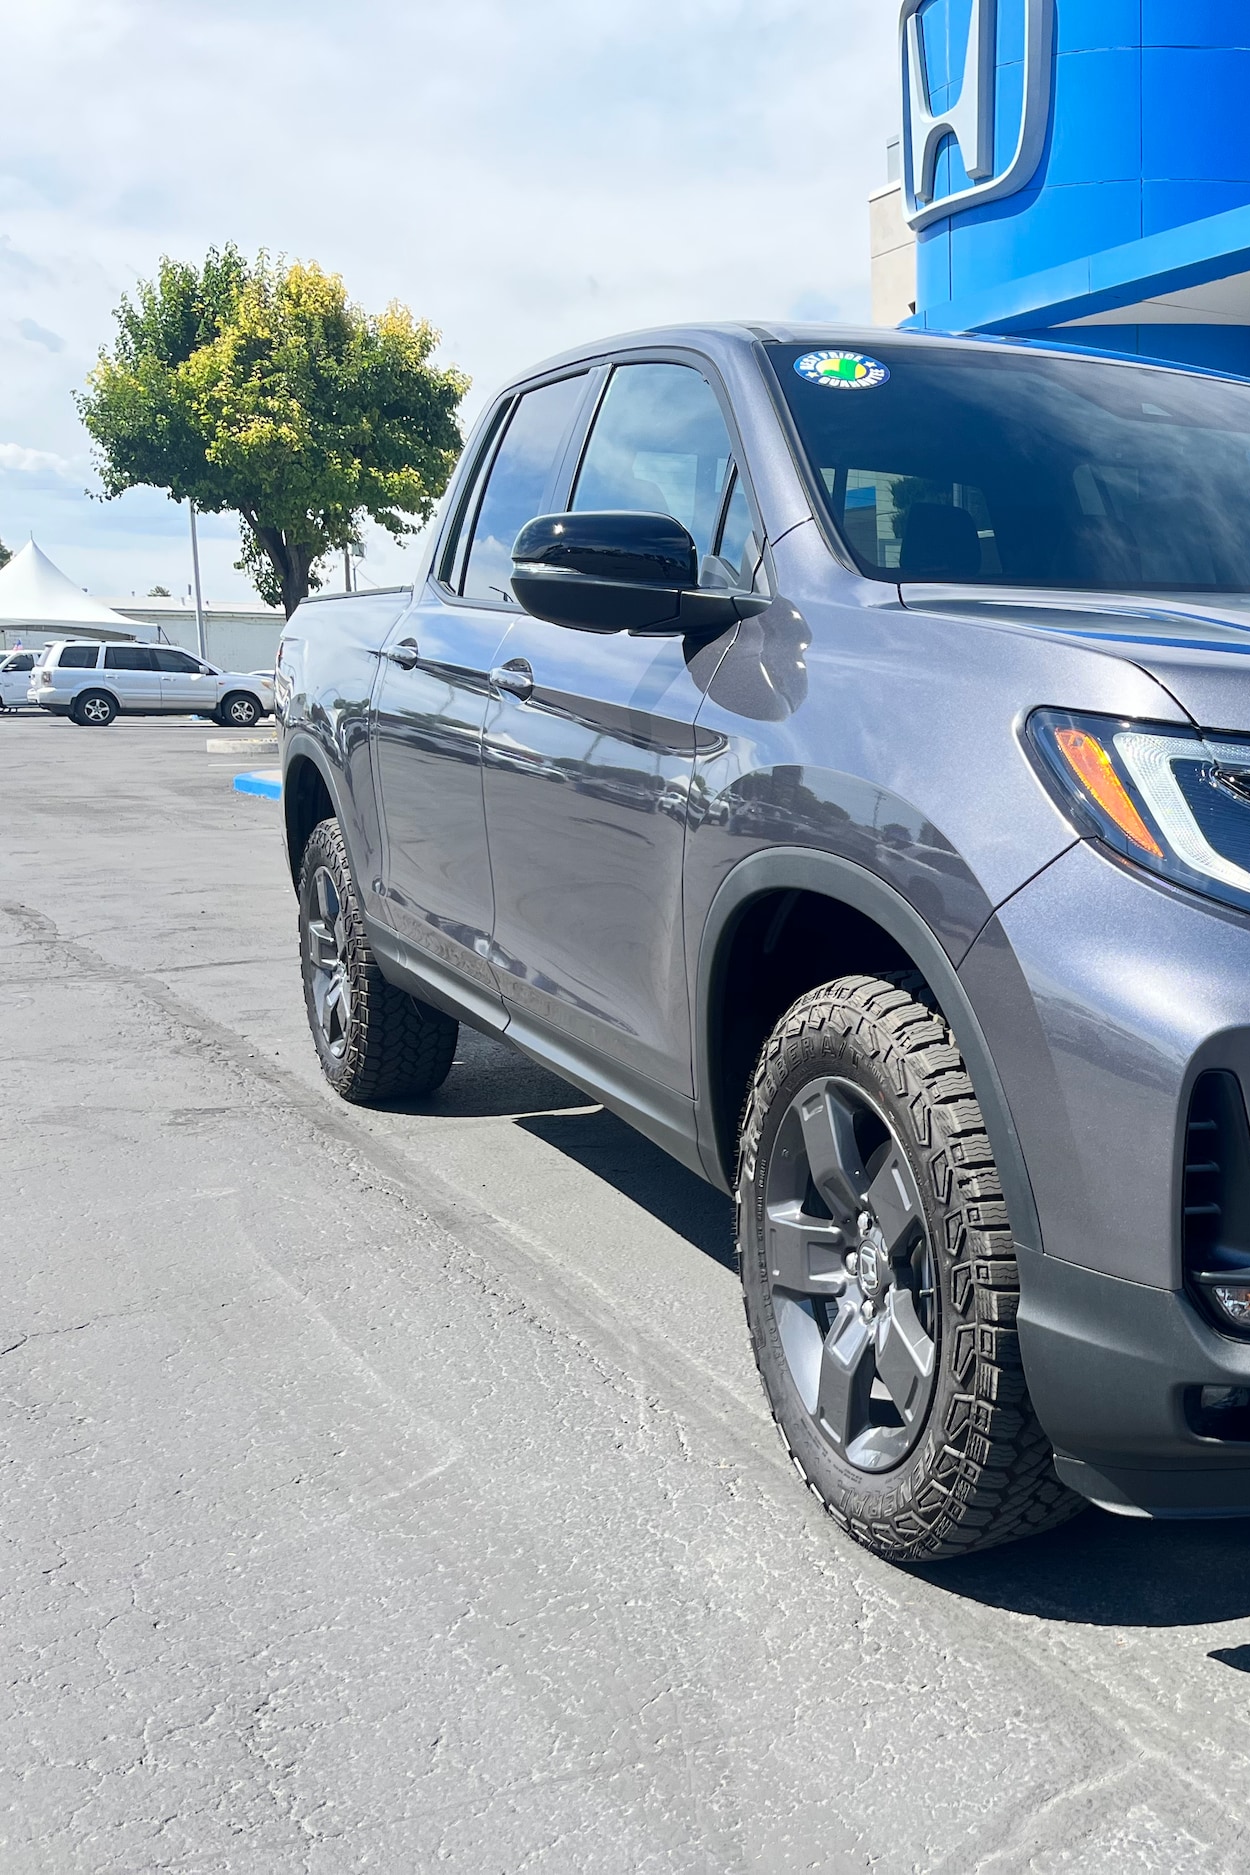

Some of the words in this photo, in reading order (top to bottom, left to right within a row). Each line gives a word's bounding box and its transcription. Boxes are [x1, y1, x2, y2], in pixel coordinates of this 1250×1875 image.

[818, 351, 863, 362] PRICE
[818, 368, 885, 388] GUARANTEE
[745, 1035, 815, 1182] GRABBER
[838, 1429, 936, 1519] GENERAL
